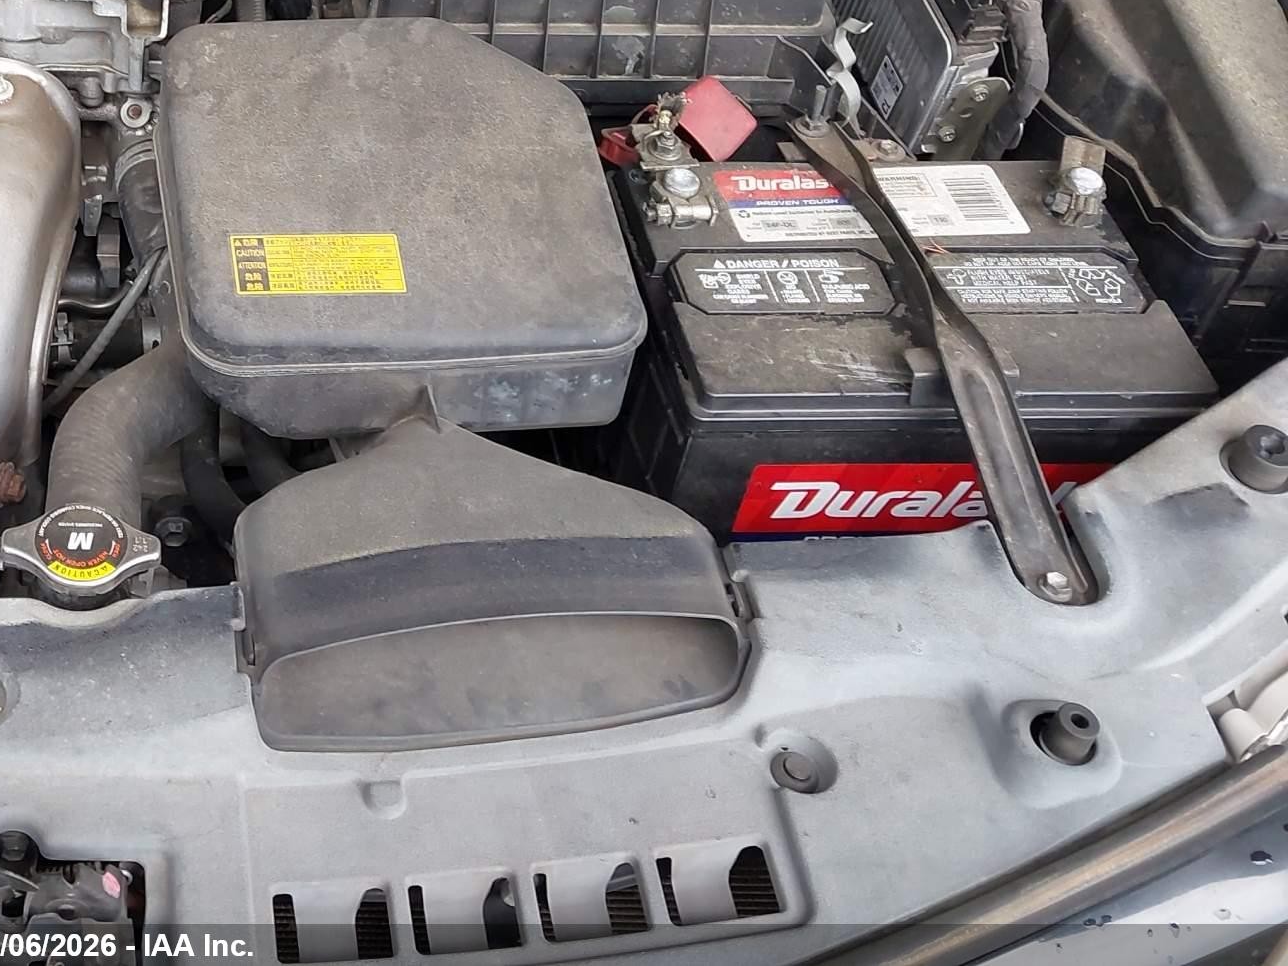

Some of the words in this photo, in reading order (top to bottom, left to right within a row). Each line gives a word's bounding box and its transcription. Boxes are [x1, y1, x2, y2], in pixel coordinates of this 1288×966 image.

[725, 259, 779, 268] DANGER
[792, 259, 839, 268] POISON
[770, 481, 1076, 519] Durala
[67, 532, 94, 550] M
[65, 557, 87, 567] OPEN
[87, 550, 108, 566] NEVER
[55, 564, 100, 578] CAUTION
